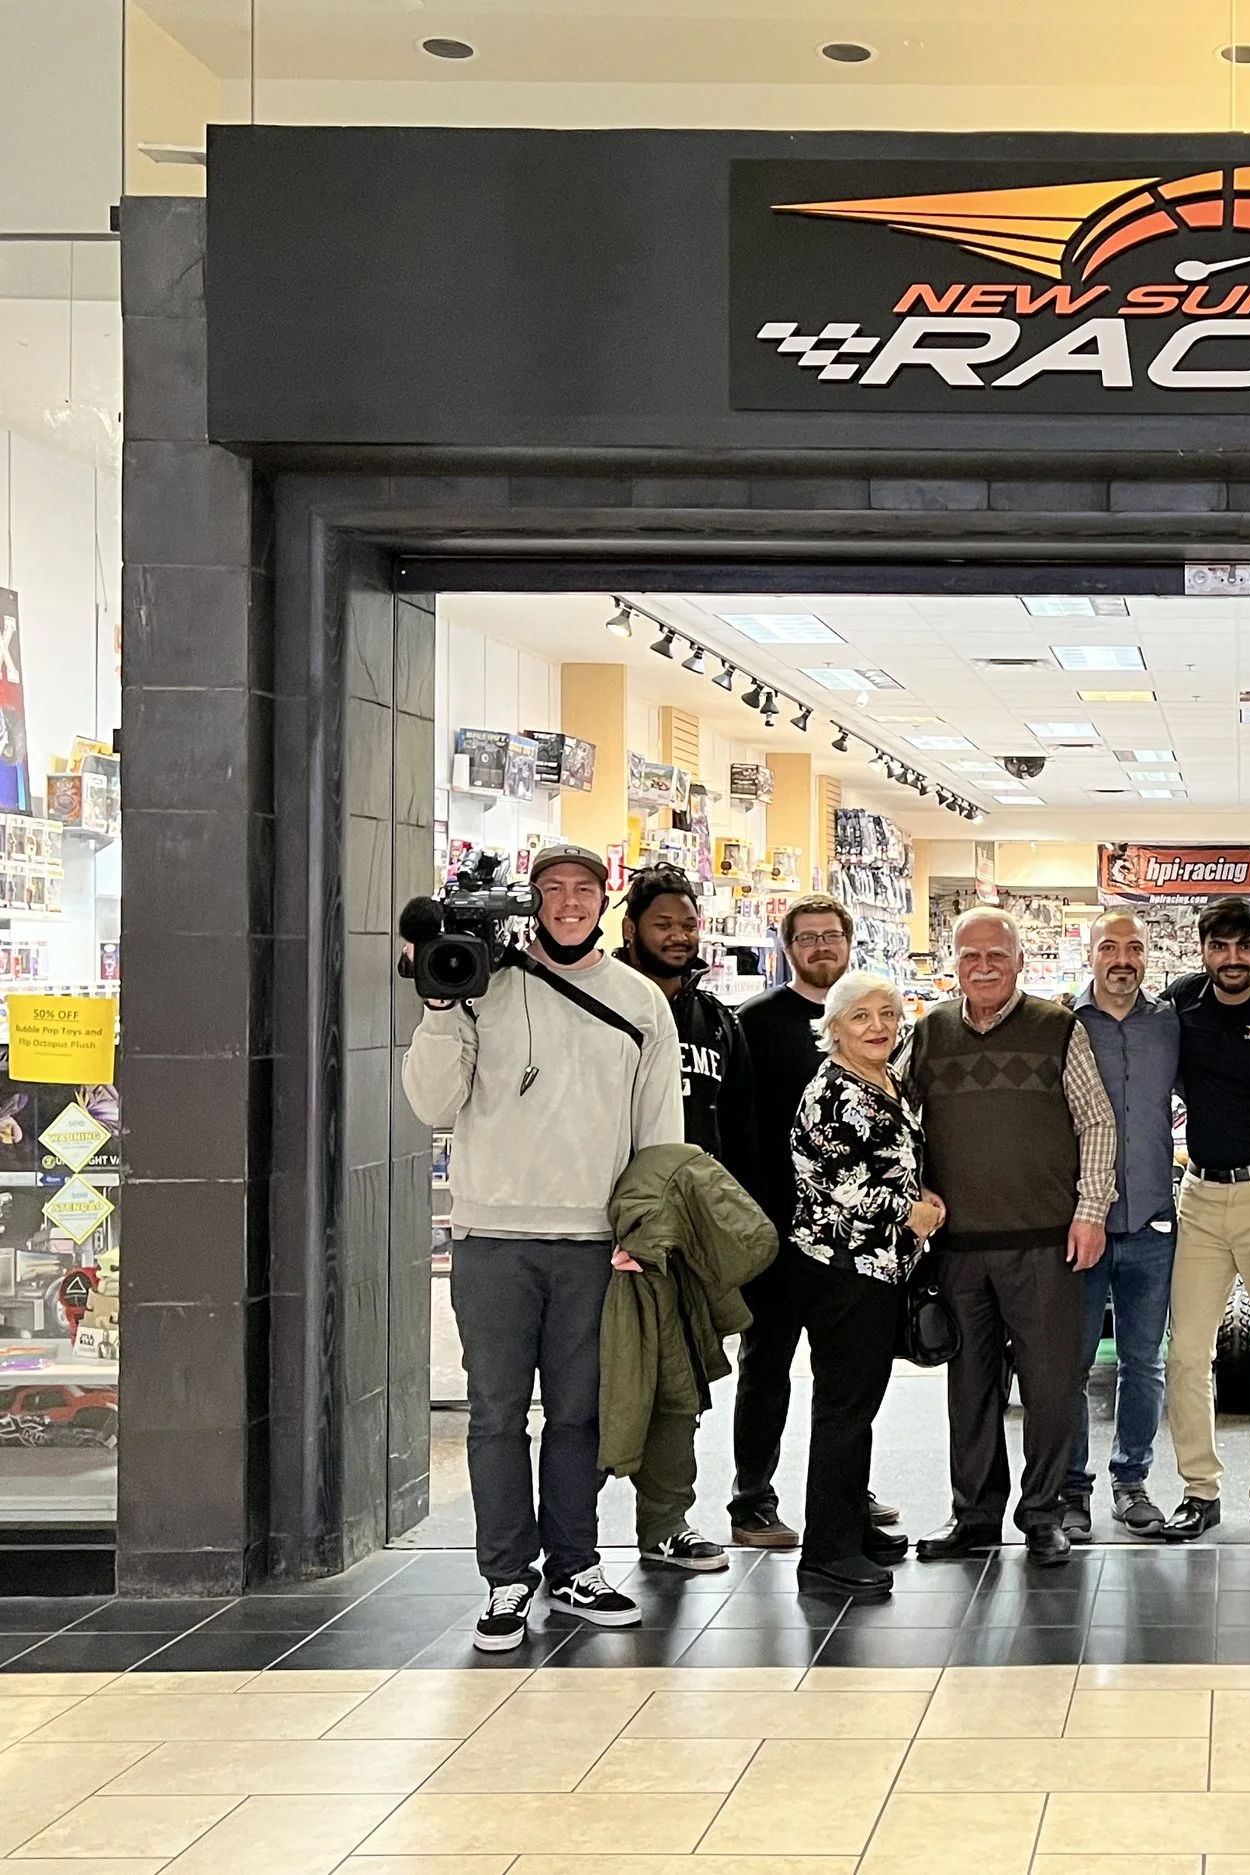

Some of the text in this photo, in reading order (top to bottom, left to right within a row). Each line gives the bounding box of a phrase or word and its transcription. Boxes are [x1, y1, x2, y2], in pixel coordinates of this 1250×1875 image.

[893, 284, 1111, 314] NEW
[33, 1009, 80, 1020] 50% OFF
[15, 1024, 103, 1036] Bubble Pop Toys and
[33, 1039, 68, 1049] Octopus
[70, 1040, 96, 1049] Plush
[48, 1131, 101, 1143] WARNING
